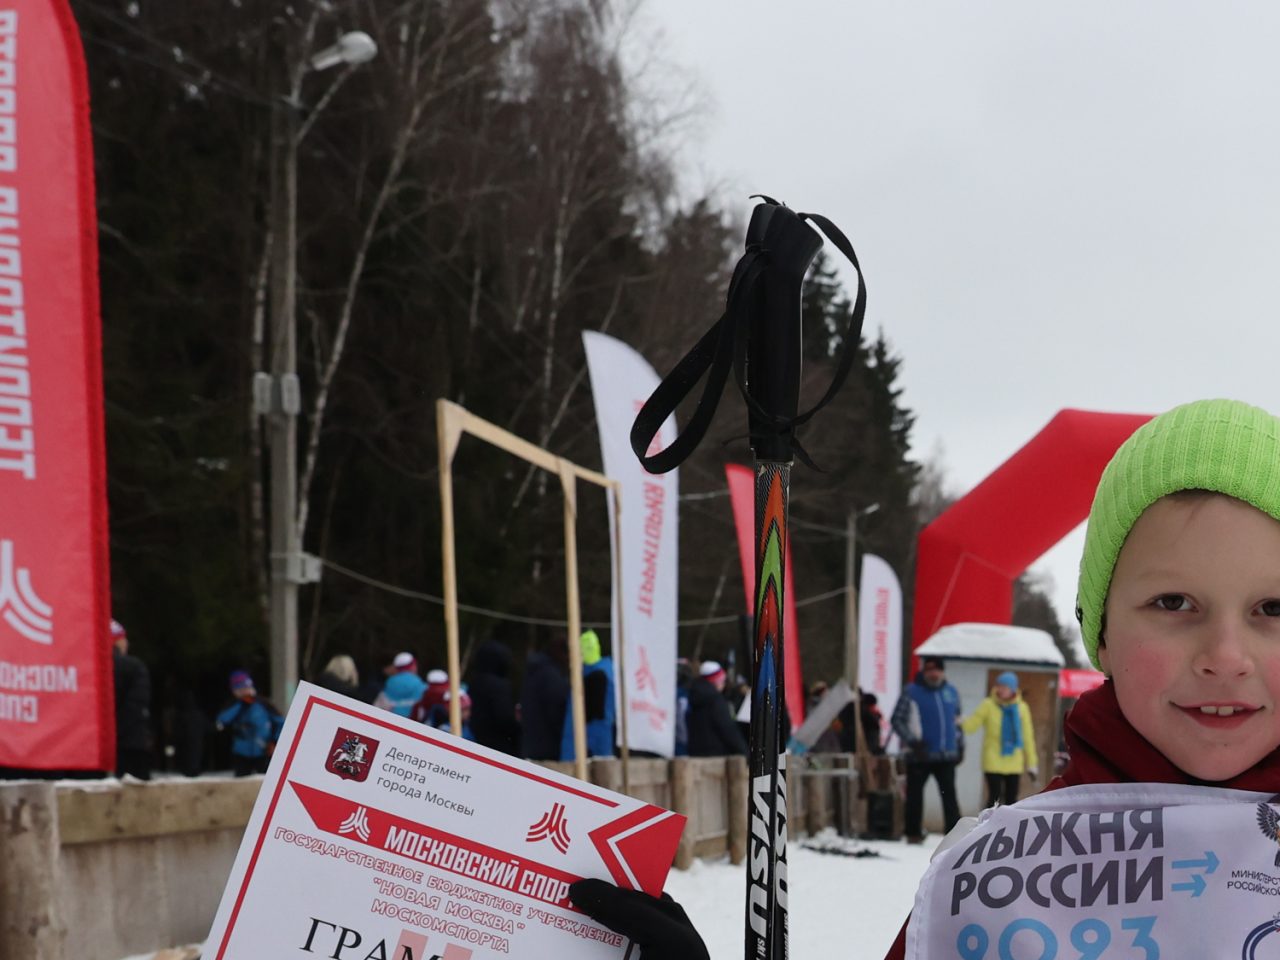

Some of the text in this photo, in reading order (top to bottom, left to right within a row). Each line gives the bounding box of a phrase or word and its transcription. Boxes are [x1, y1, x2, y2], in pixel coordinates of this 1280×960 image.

[381, 762, 426, 785] спорта
[384, 746, 472, 784] Департамент
[376, 776, 475, 817] города Москвы
[383, 825, 573, 908] МОСКОВСКИЙ СПОР
[952, 807, 1164, 870] ЛЫЖНЯ
[273, 826, 624, 948] ГОСУДАРСТВЕННОЕ БЮДЖЕТНОЕ УЧРЕЖДЕНИЕ
[951, 856, 1164, 915] РОССИИ
[370, 897, 510, 954] МОСКОМСПОРТА
